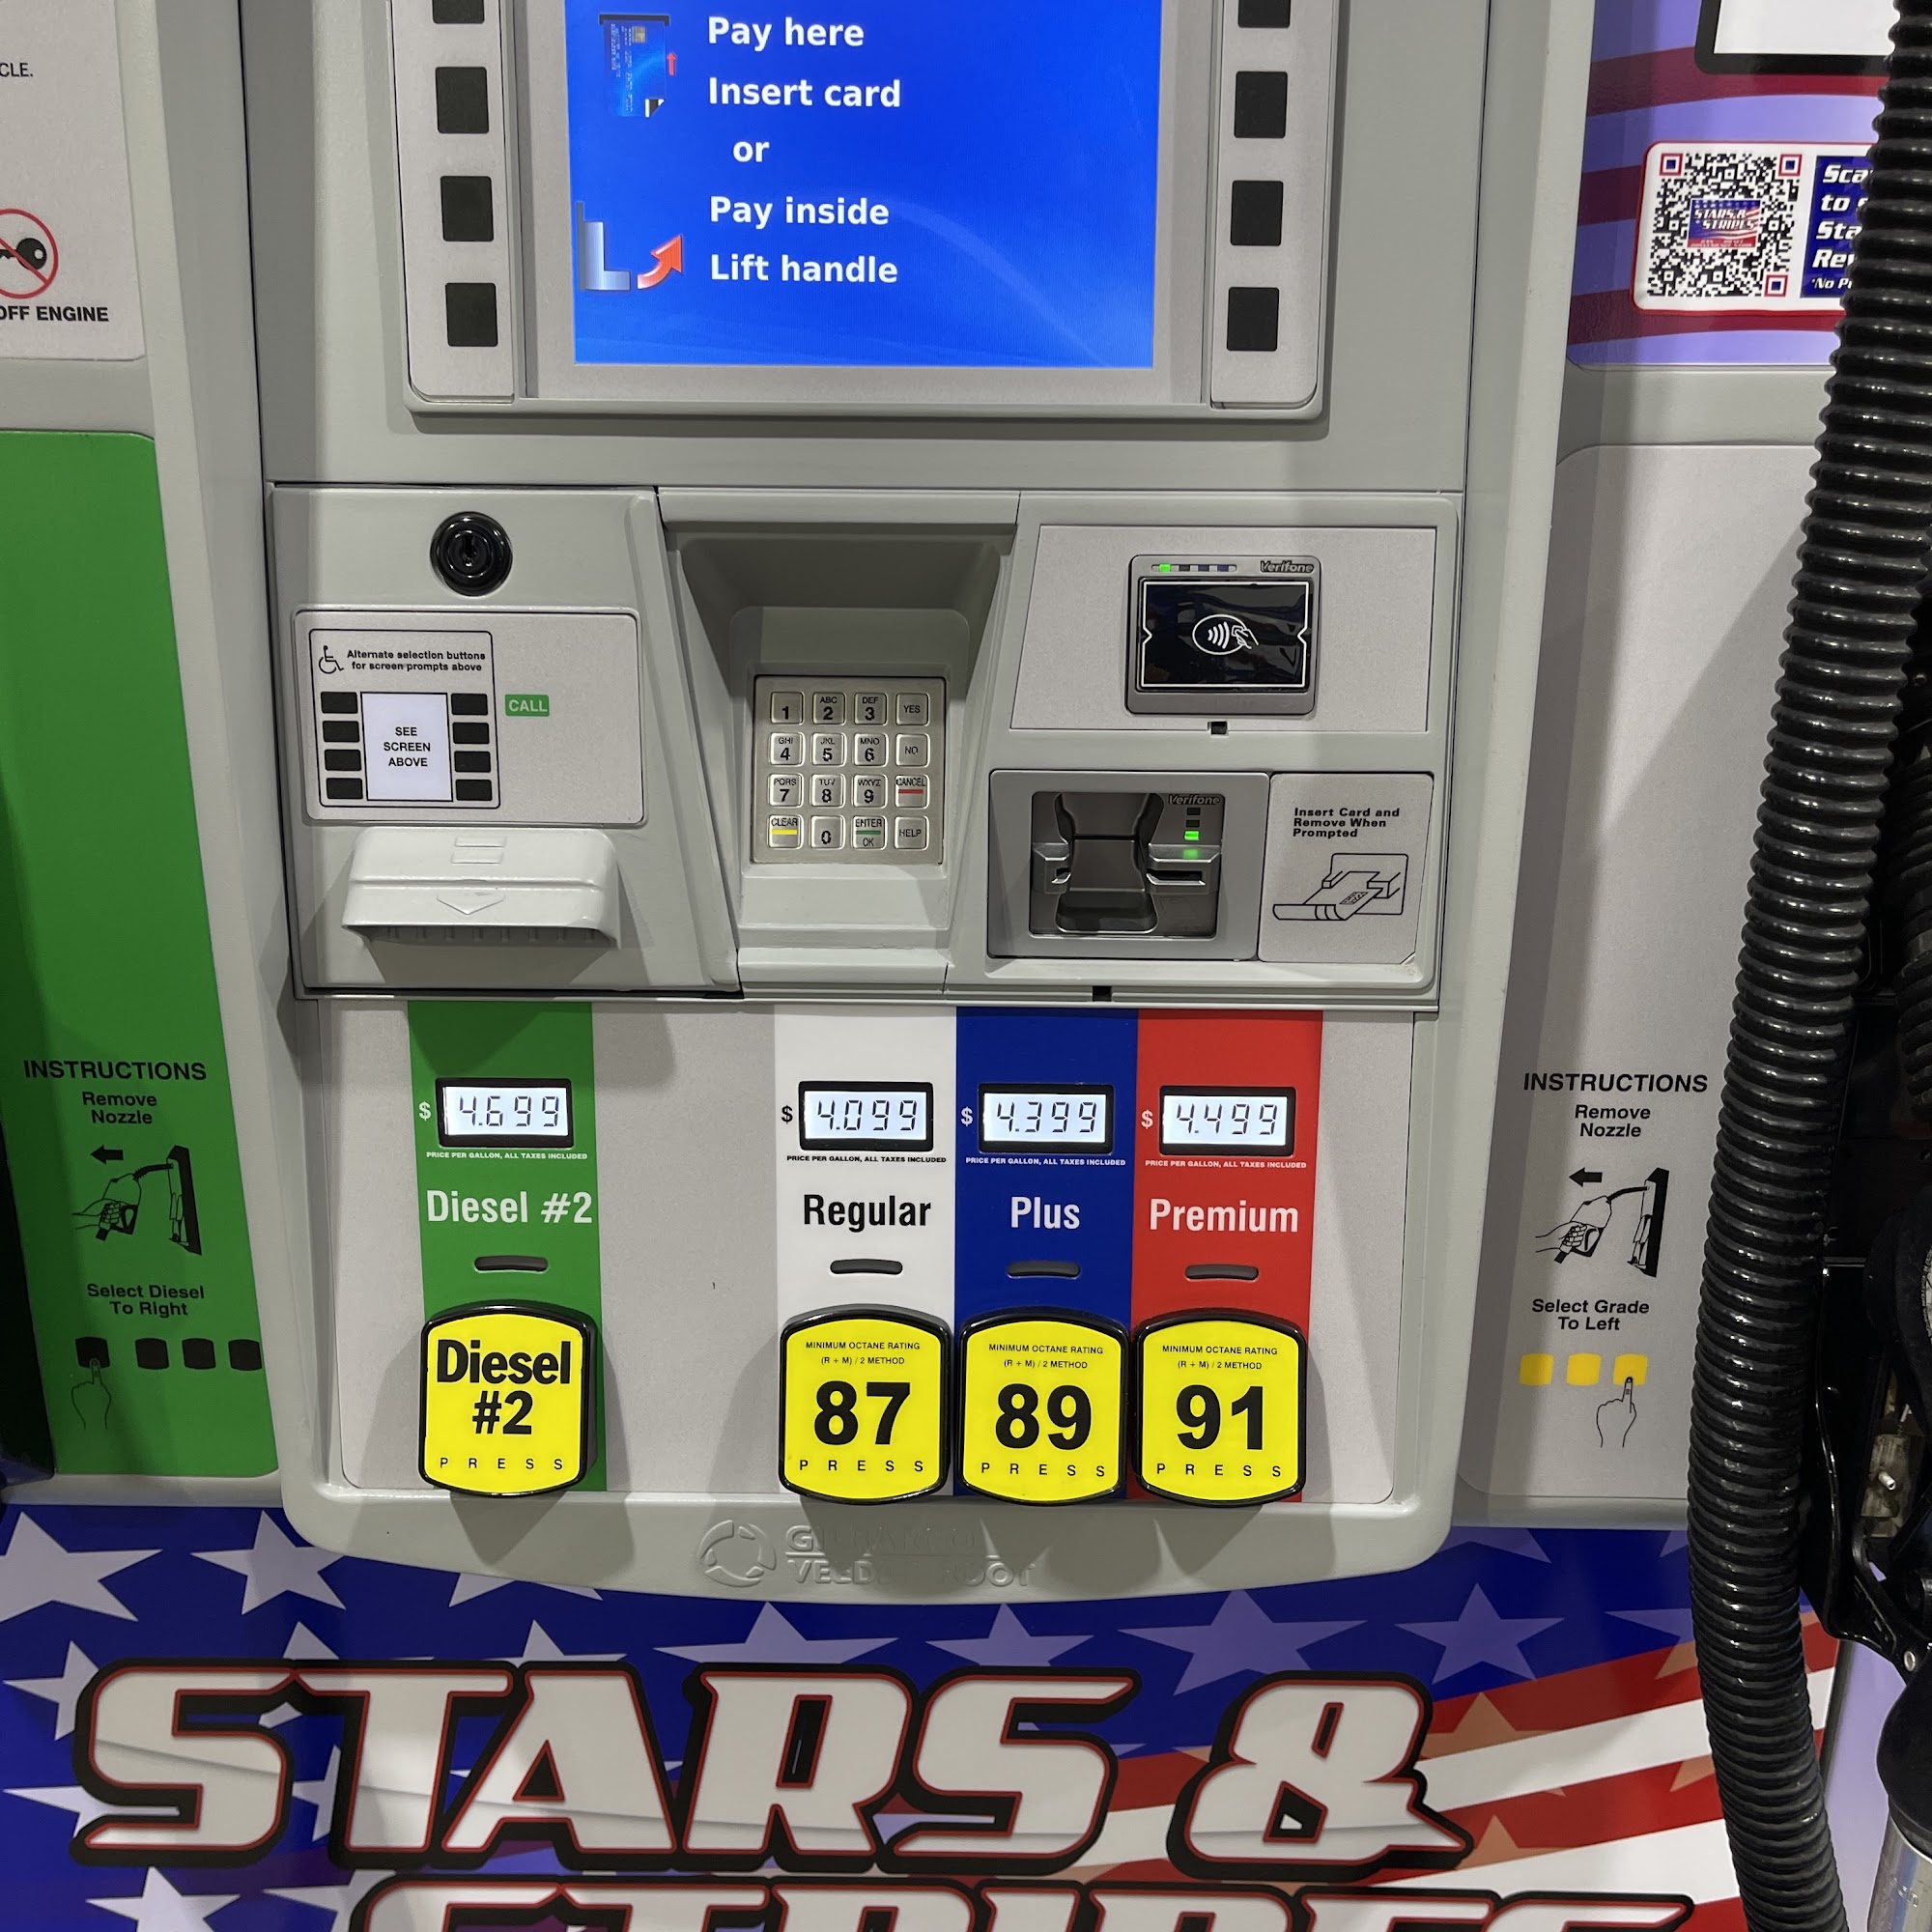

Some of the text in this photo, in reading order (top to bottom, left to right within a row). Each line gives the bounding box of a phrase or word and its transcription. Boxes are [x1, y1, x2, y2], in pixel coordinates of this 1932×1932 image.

[709, 16, 865, 51] Pay here
[709, 77, 901, 107] Insert card
[732, 140, 770, 162] or
[1822, 164, 1873, 184] Sca
[1821, 194, 1851, 212] to
[710, 196, 890, 230] Pay inside
[710, 253, 898, 283] Lift handle
[37, 305, 110, 322] ENGINE
[1260, 560, 1314, 574] Verifone
[347, 649, 486, 661] Alternate selection buttons
[352, 661, 482, 672] for screen prompts above
[508, 699, 548, 713] CALL
[781, 706, 790, 720] 1
[903, 705, 921, 714] YES
[823, 706, 834, 721] 2
[865, 706, 875, 721] 3
[394, 726, 418, 737] SEE
[384, 742, 431, 753] SCREEN
[860, 737, 880, 746] MNO
[780, 747, 790, 761] 4
[822, 748, 833, 761] 5
[865, 748, 875, 762] 6
[904, 746, 919, 755] NO
[387, 757, 428, 768] ABOVE
[774, 778, 797, 786] PQRS
[818, 778, 836, 786] TUV
[857, 779, 882, 787] WXYZ
[895, 777, 926, 786] CANCEL
[780, 788, 790, 803] 7
[821, 788, 832, 804] 8
[864, 789, 874, 804] 9
[1168, 794, 1221, 806] Verifone
[1293, 808, 1401, 817] Insert Card and
[771, 817, 798, 827] CLEAR
[855, 818, 883, 828] ENTER
[1293, 818, 1387, 828] Remove When
[821, 830, 832, 844] 0
[898, 828, 923, 838] HELP
[1293, 829, 1358, 839] Prompted
[863, 838, 874, 847] OK
[23, 1060, 207, 1080] INSTRUCTIONS
[1523, 1072, 1708, 1093] INSTRUCTIONS
[82, 1091, 157, 1106] Remove
[91, 1110, 153, 1124] Nozzle
[418, 1095, 560, 1126] $ 4.699
[781, 1099, 918, 1131] $ 4.099
[961, 1101, 1097, 1133] $ 4.399
[1575, 1104, 1651, 1120] Remove
[1141, 1103, 1278, 1135] $ 4.499
[1579, 1122, 1642, 1137] Nozzle
[469, 1151, 502, 1160] GALLON,
[1008, 1157, 1041, 1166] GALLON,
[1187, 1160, 1222, 1169] GALLON,
[426, 1189, 592, 1223] Diesel #2
[1010, 1196, 1081, 1230] Plus
[804, 1194, 931, 1233] Regular
[1150, 1198, 1299, 1233] Premium
[87, 1283, 205, 1299] Select Diesel
[110, 1301, 188, 1319] To Right
[1531, 1298, 1650, 1314] Select Grade
[1557, 1317, 1621, 1331] To Left
[806, 1341, 846, 1350] MINIMUM
[888, 1342, 920, 1350] RATING
[989, 1344, 1029, 1352] MINIMUM
[1070, 1346, 1103, 1354] RATING
[1162, 1345, 1278, 1355] MINIMUM OCTANE RATING
[437, 1339, 571, 1384] Diesel
[867, 1356, 905, 1365] METHOD
[1050, 1360, 1088, 1369] METHOD
[1224, 1361, 1263, 1370] METHOD
[472, 1390, 533, 1435] #2
[813, 1380, 911, 1445] 87
[995, 1383, 1092, 1451] 89
[1176, 1384, 1264, 1450] 91
[440, 1457, 562, 1470] PRESS
[799, 1460, 923, 1472] PRESS
[980, 1463, 1105, 1477] PRESS
[1156, 1463, 1281, 1477] PRESS
[71, 1659, 1474, 1878] STARS &
